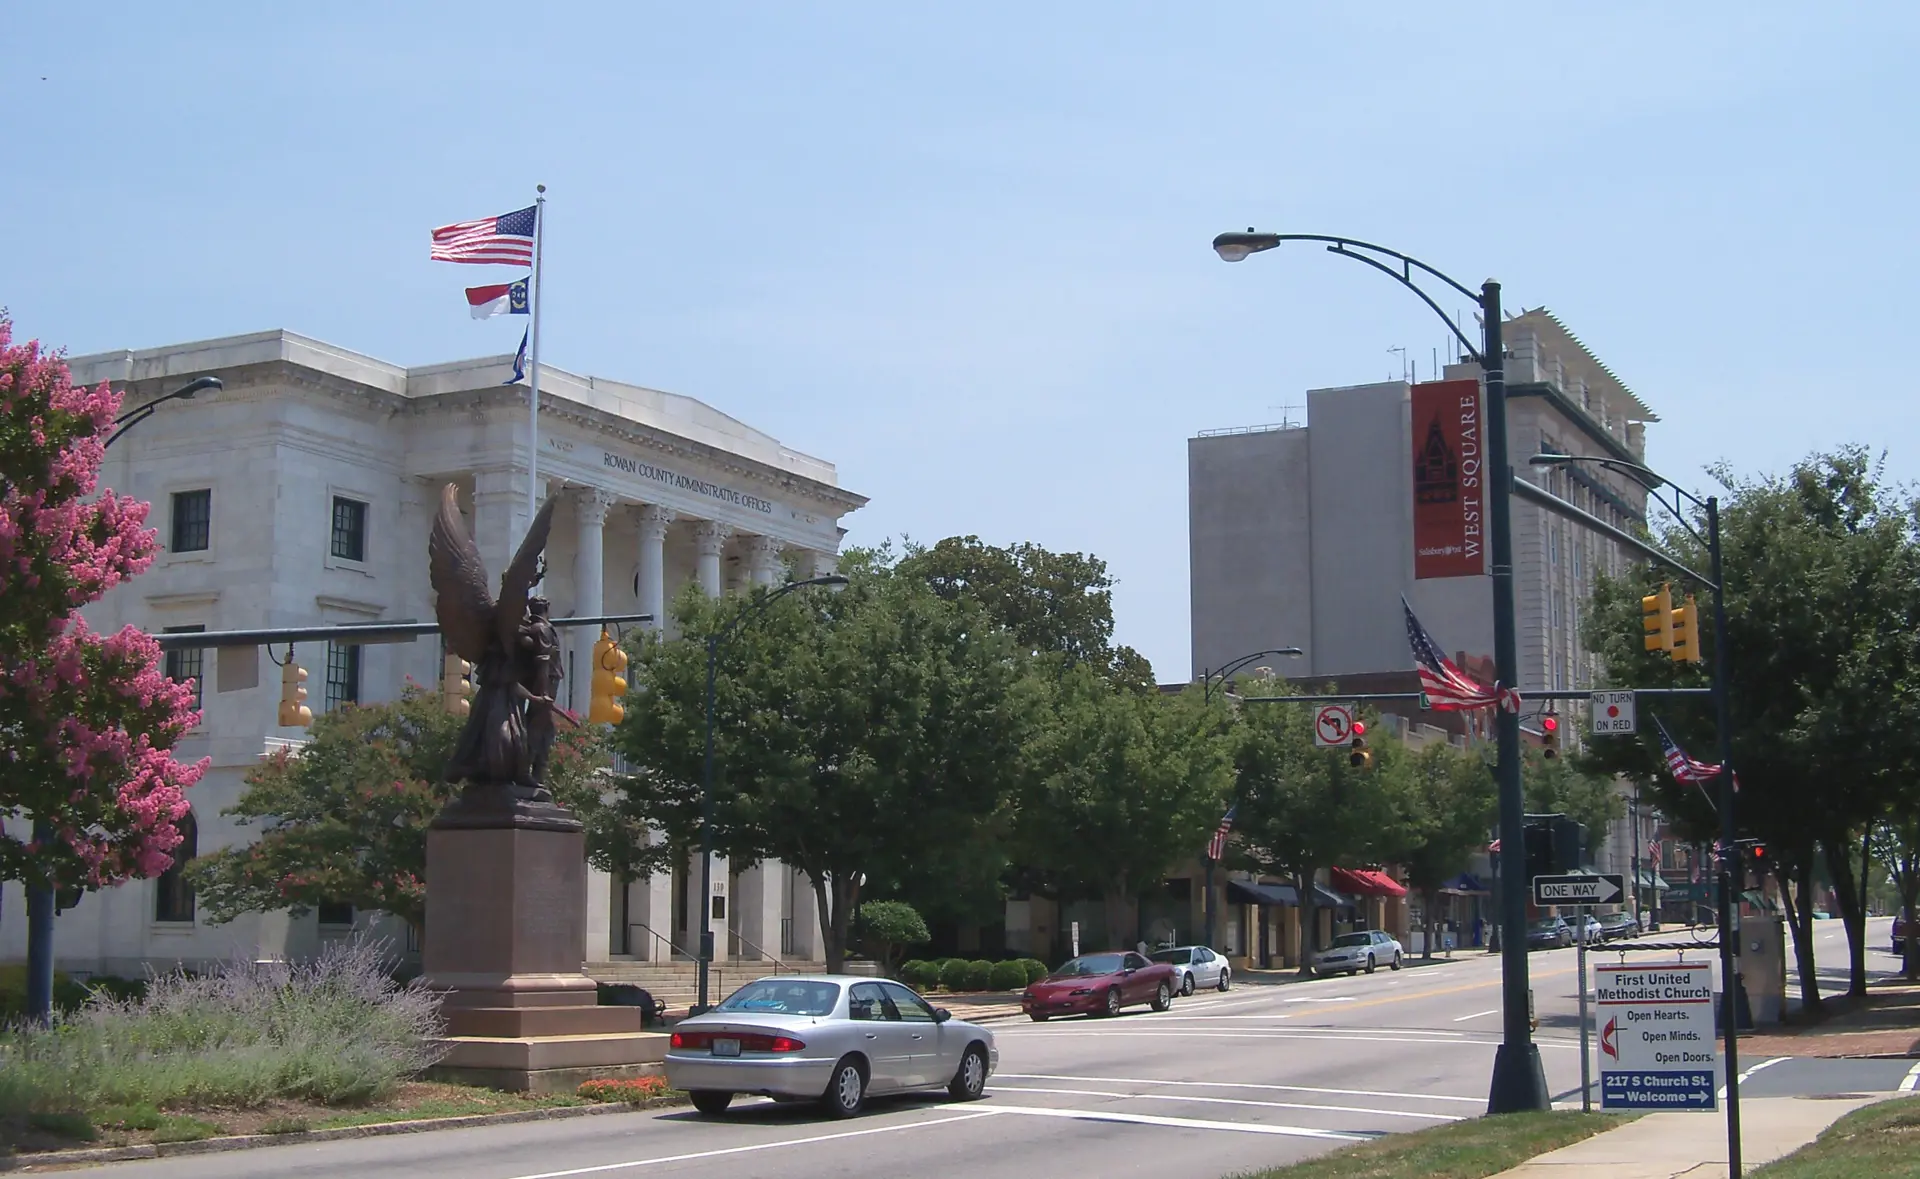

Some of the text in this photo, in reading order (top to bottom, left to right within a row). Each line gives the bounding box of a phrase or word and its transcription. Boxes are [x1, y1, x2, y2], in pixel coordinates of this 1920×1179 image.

[604, 452, 771, 513] ROWAN COUNTY ADMINISTRATIVE OFFICES
[1460, 395, 1480, 560] WEST SQUARE
[1593, 693, 1632, 704] NO TURN
[1596, 720, 1631, 731] ON RED
[1544, 884, 1597, 896] ONE WAY
[1615, 973, 1691, 986] First United
[1598, 987, 1711, 1000] Methodist Church
[1627, 1010, 1690, 1022] Open Hearts.
[1642, 1031, 1701, 1043] Open Minds.
[1655, 1052, 1714, 1064] Open Doors.
[1606, 1075, 1710, 1087] 217 S Church St.
[1626, 1091, 1687, 1102] Welcome
